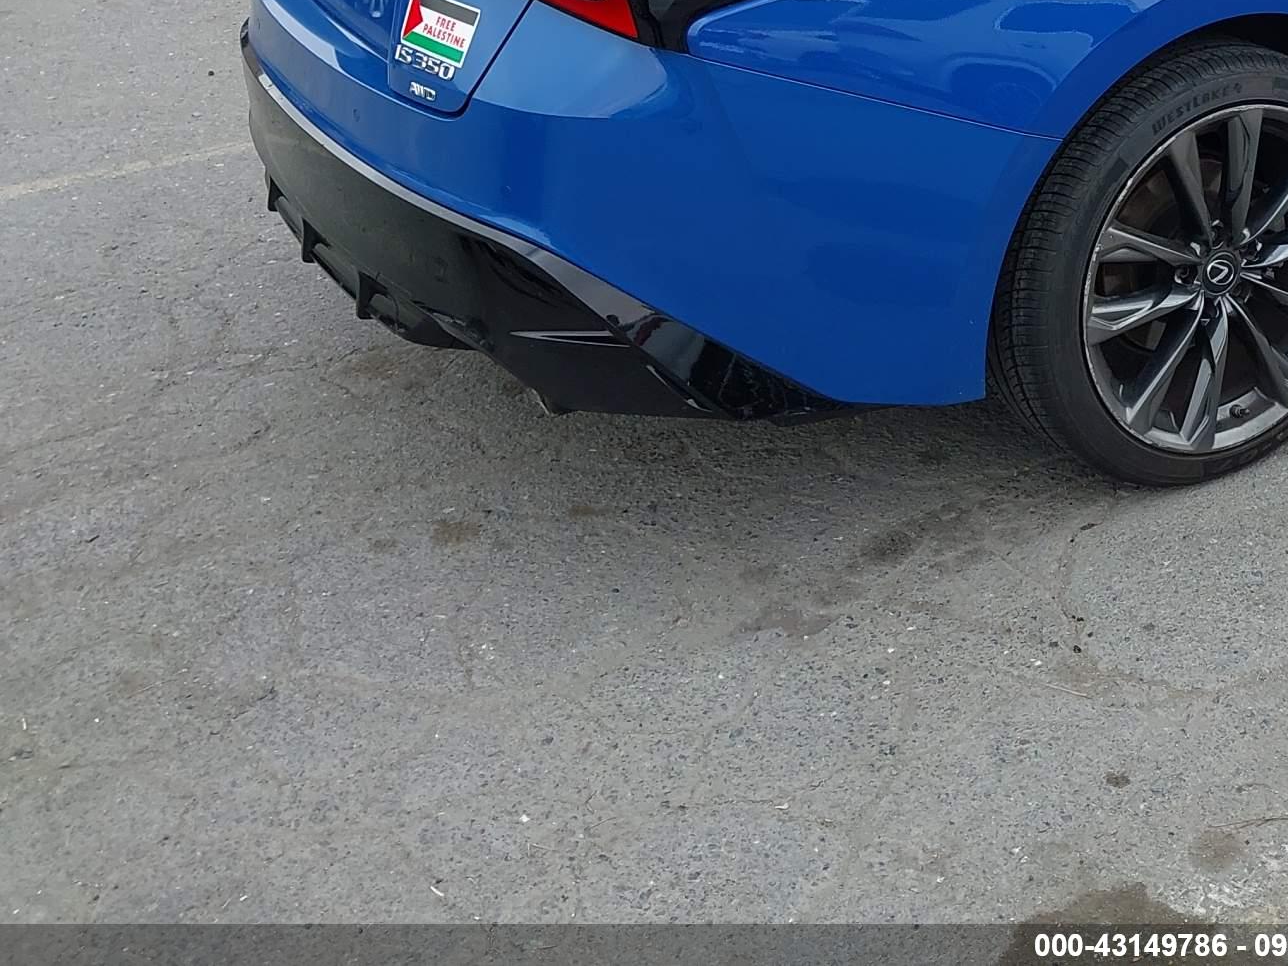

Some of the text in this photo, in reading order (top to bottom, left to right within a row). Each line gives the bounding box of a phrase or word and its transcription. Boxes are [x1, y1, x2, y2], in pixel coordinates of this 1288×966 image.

[436, 16, 457, 32] FREE
[423, 23, 466, 48] PALESTINE
[412, 52, 455, 80] 350
[409, 81, 436, 101] AWD
